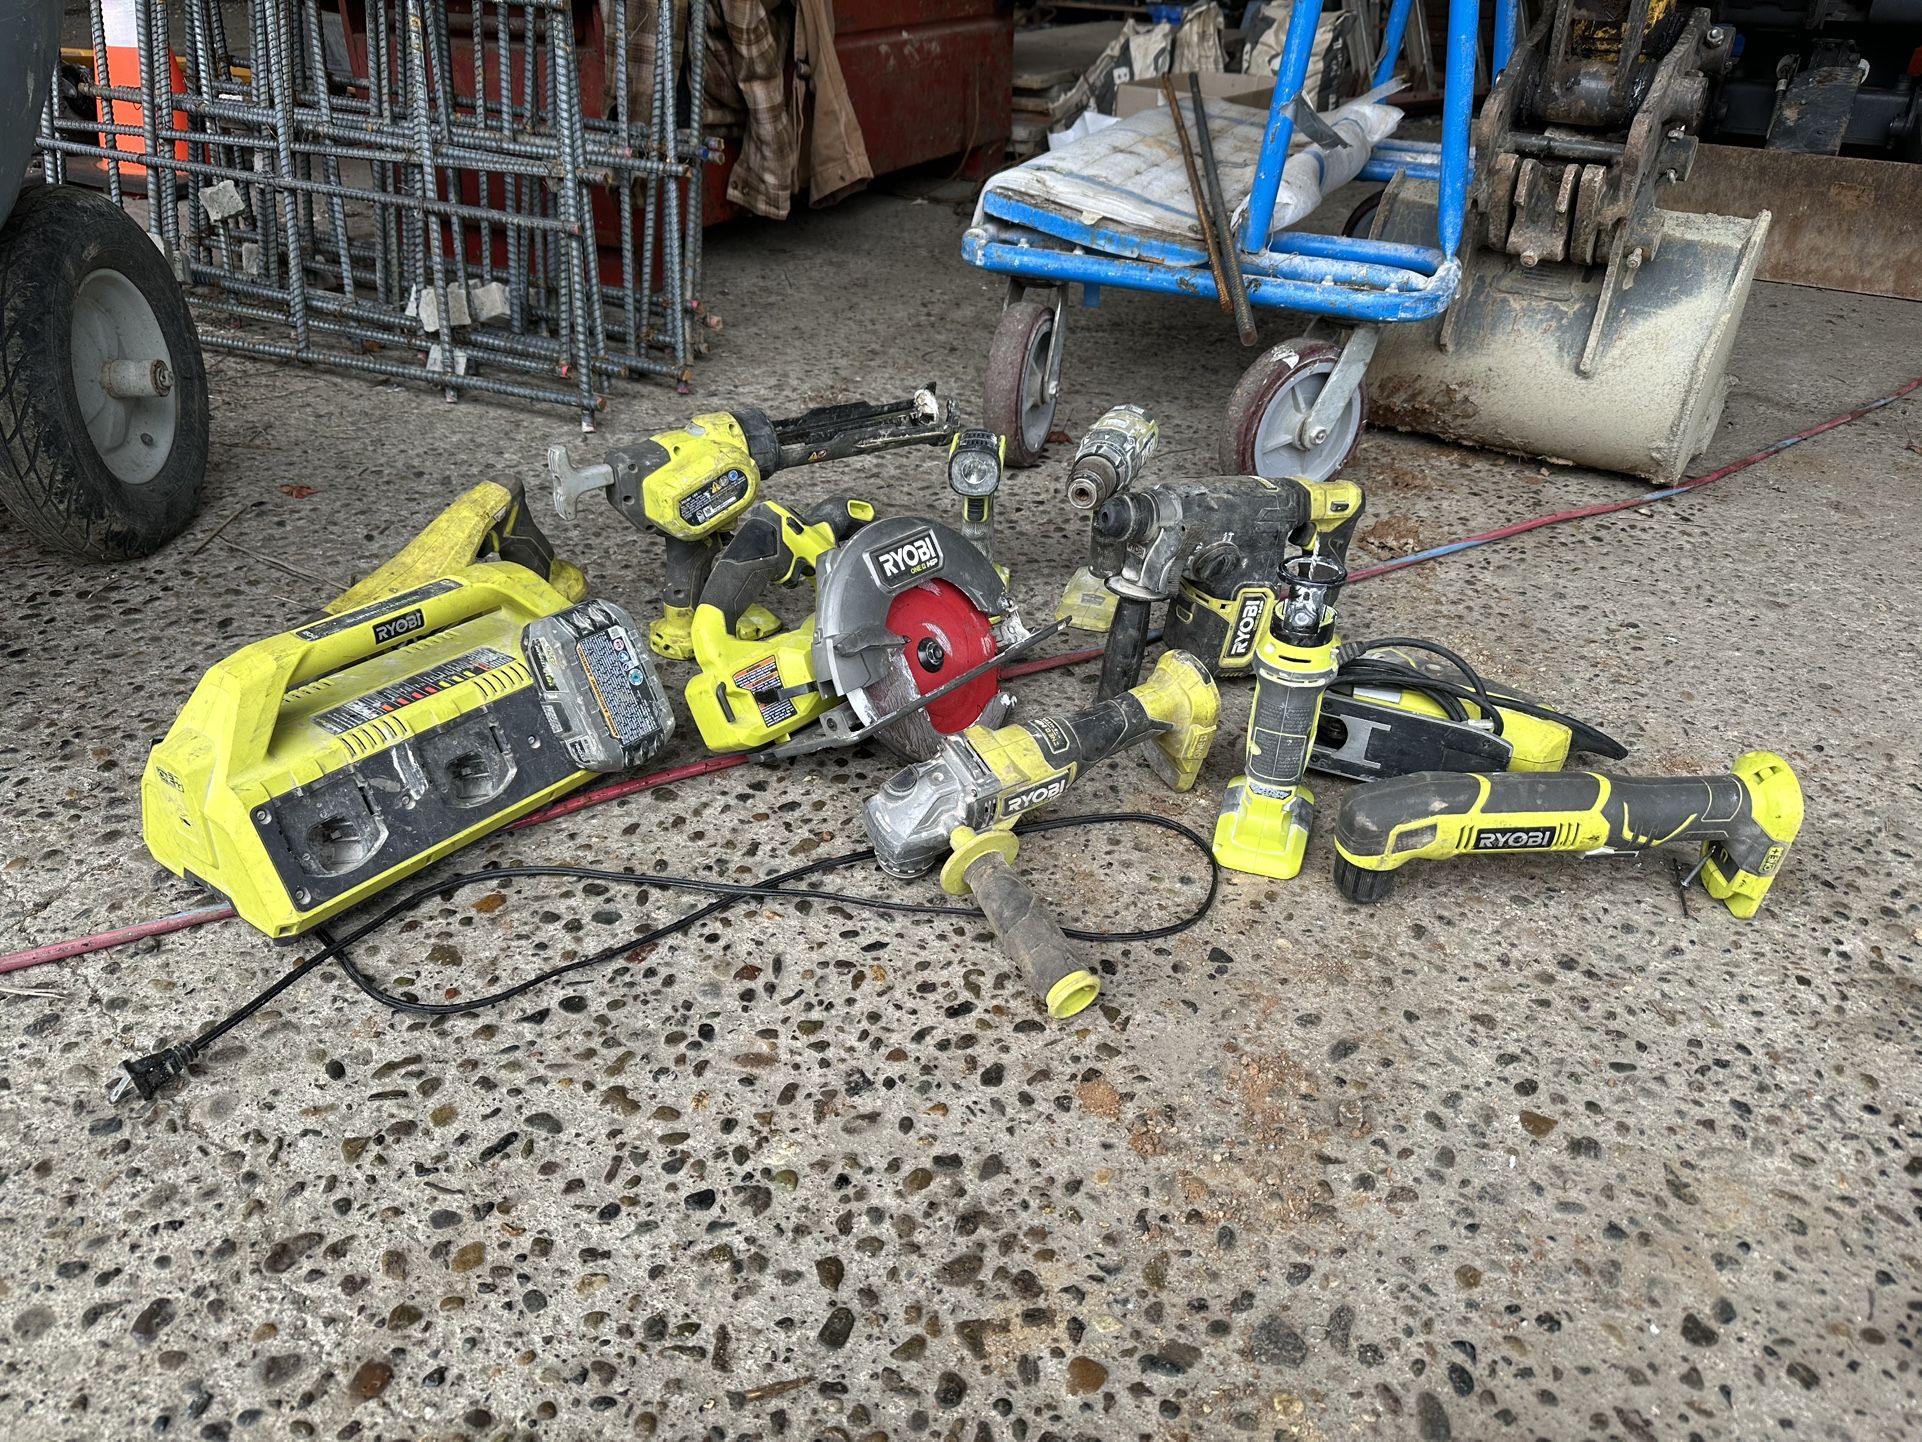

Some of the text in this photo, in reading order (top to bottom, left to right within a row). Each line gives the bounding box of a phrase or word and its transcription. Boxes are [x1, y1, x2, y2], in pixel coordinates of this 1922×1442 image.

[878, 537, 936, 577] RYOBI
[375, 612, 424, 641] RYOBI
[1230, 600, 1261, 655] RYOBI
[1008, 779, 1066, 811] RYOBI
[1478, 831, 1551, 848] RYOBI
